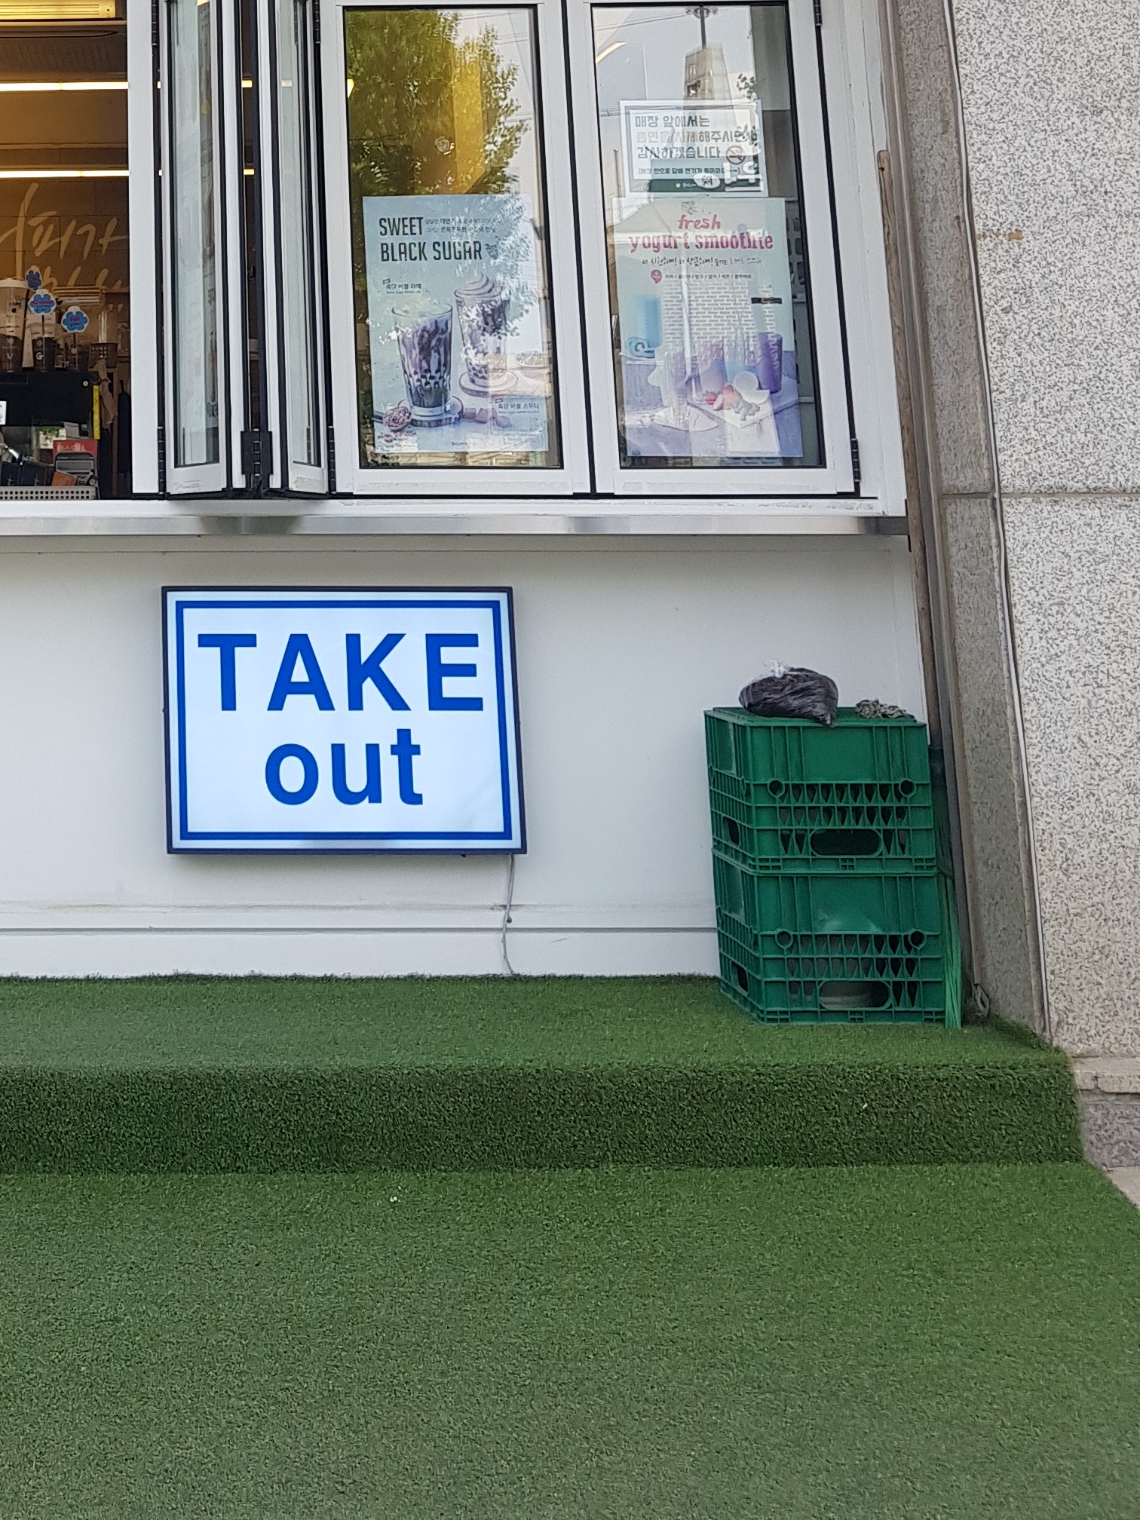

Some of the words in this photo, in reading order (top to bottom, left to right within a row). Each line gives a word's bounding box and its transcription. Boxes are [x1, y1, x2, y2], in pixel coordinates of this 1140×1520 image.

[635, 115, 659, 128] 매장
[662, 115, 710, 128] 앞에서는
[637, 146, 722, 159] 감사하겠습니다
[379, 216, 424, 236] SWEET
[677, 214, 721, 230] fresh
[380, 241, 428, 262] BLACK
[432, 240, 483, 261] SUGAR
[628, 232, 690, 253] yogurt
[197, 633, 484, 711] TAKE
[264, 728, 424, 805] out
